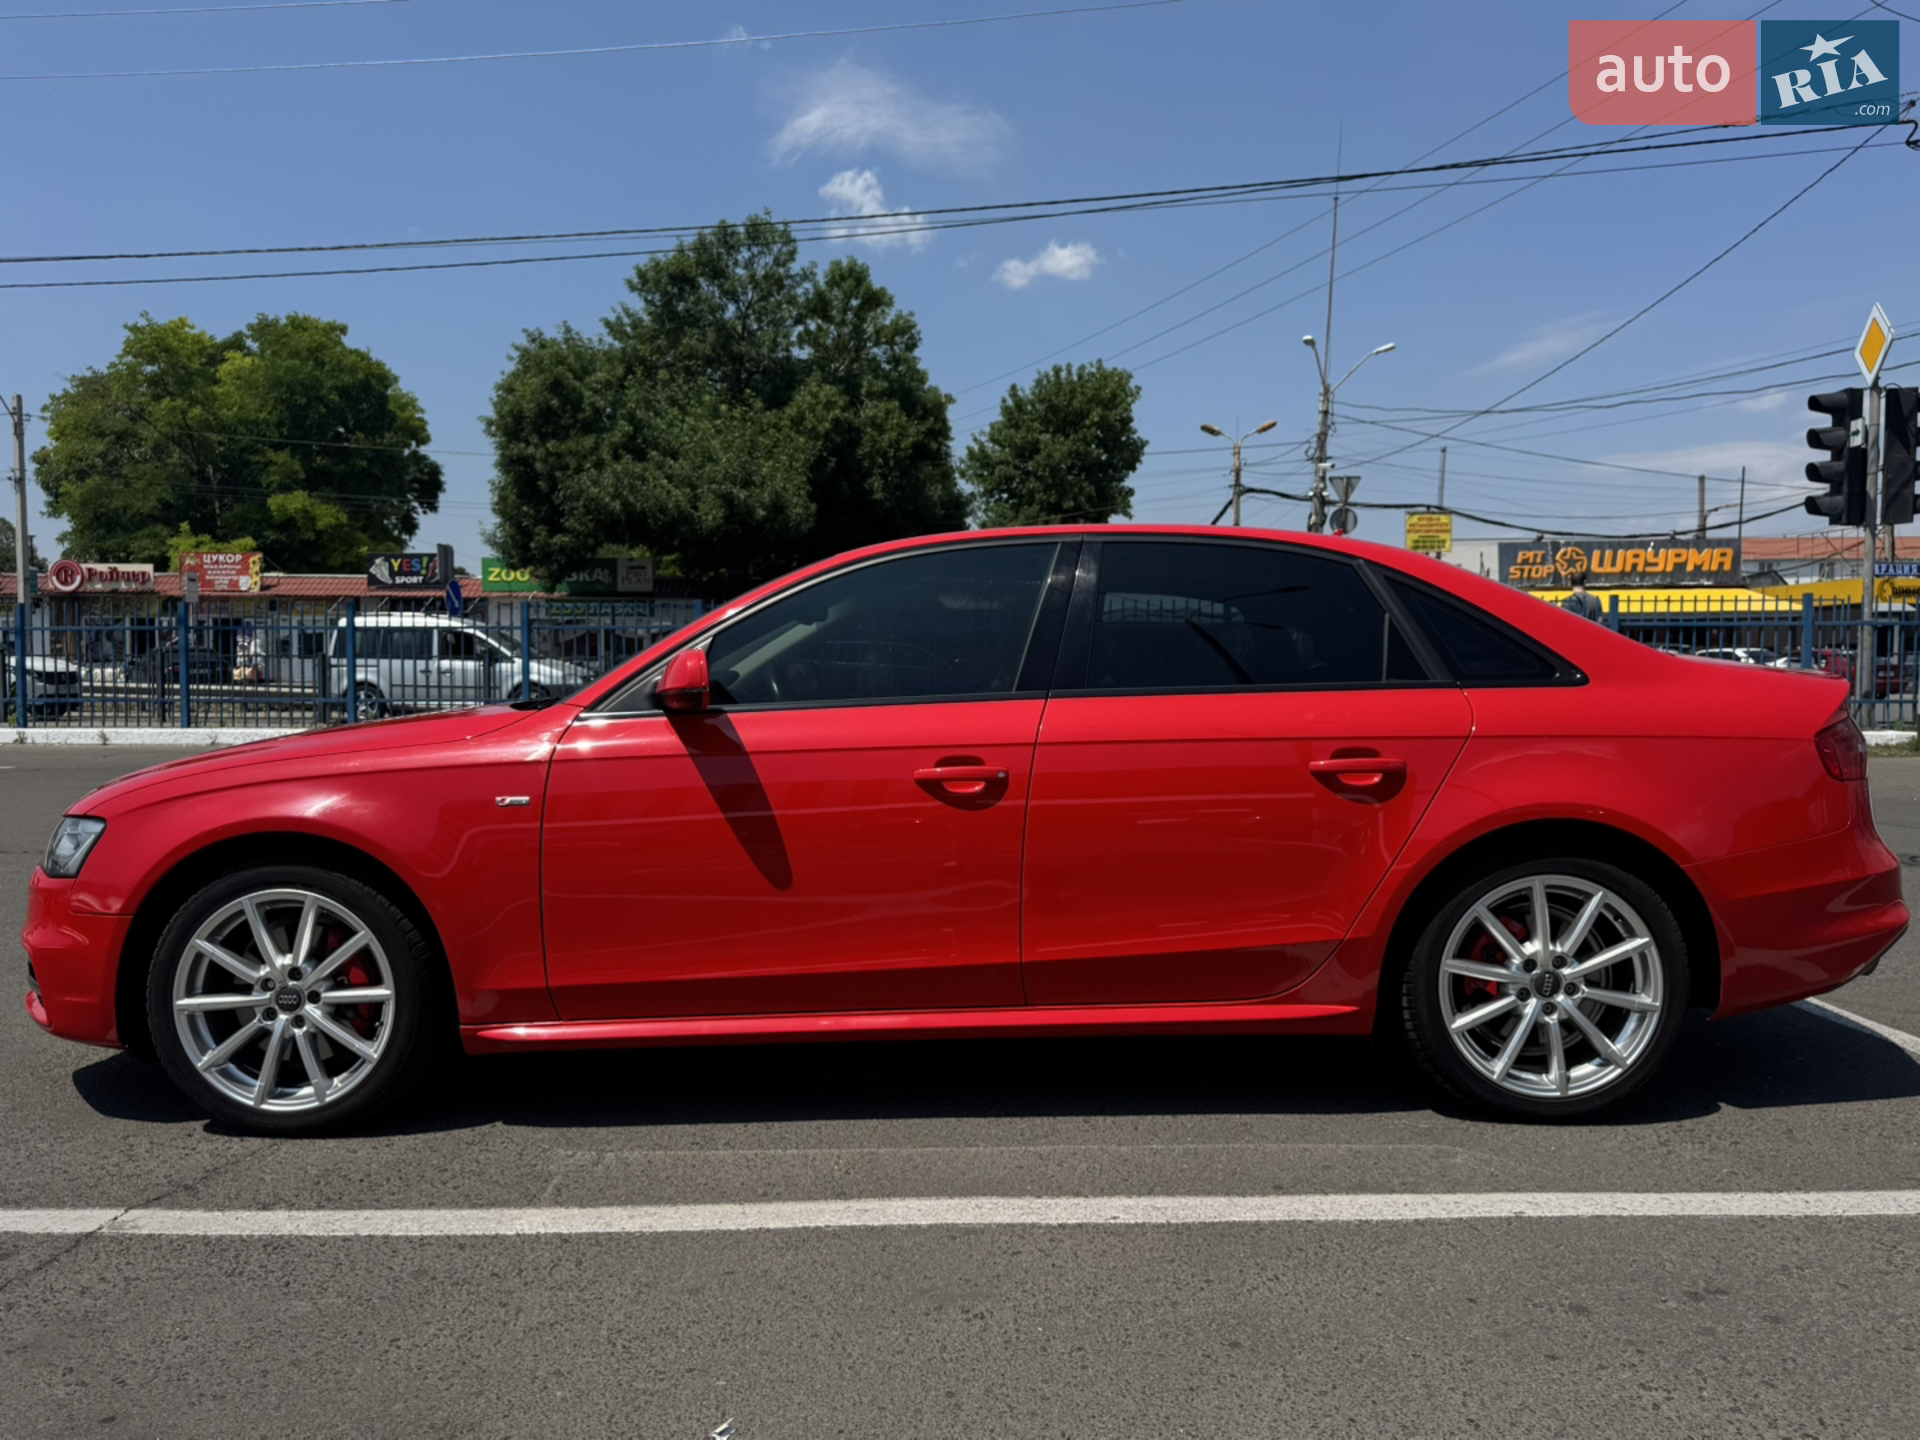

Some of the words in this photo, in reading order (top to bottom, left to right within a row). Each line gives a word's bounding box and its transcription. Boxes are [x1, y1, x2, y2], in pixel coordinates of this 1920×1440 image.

[203, 554, 242, 564] ЦУКОР
[1516, 550, 1546, 564] PIT
[1590, 547, 1734, 574] ШАУРМА
[390, 556, 429, 576] YES!
[1508, 564, 1555, 579] STOP
[394, 576, 424, 585] SPORT
